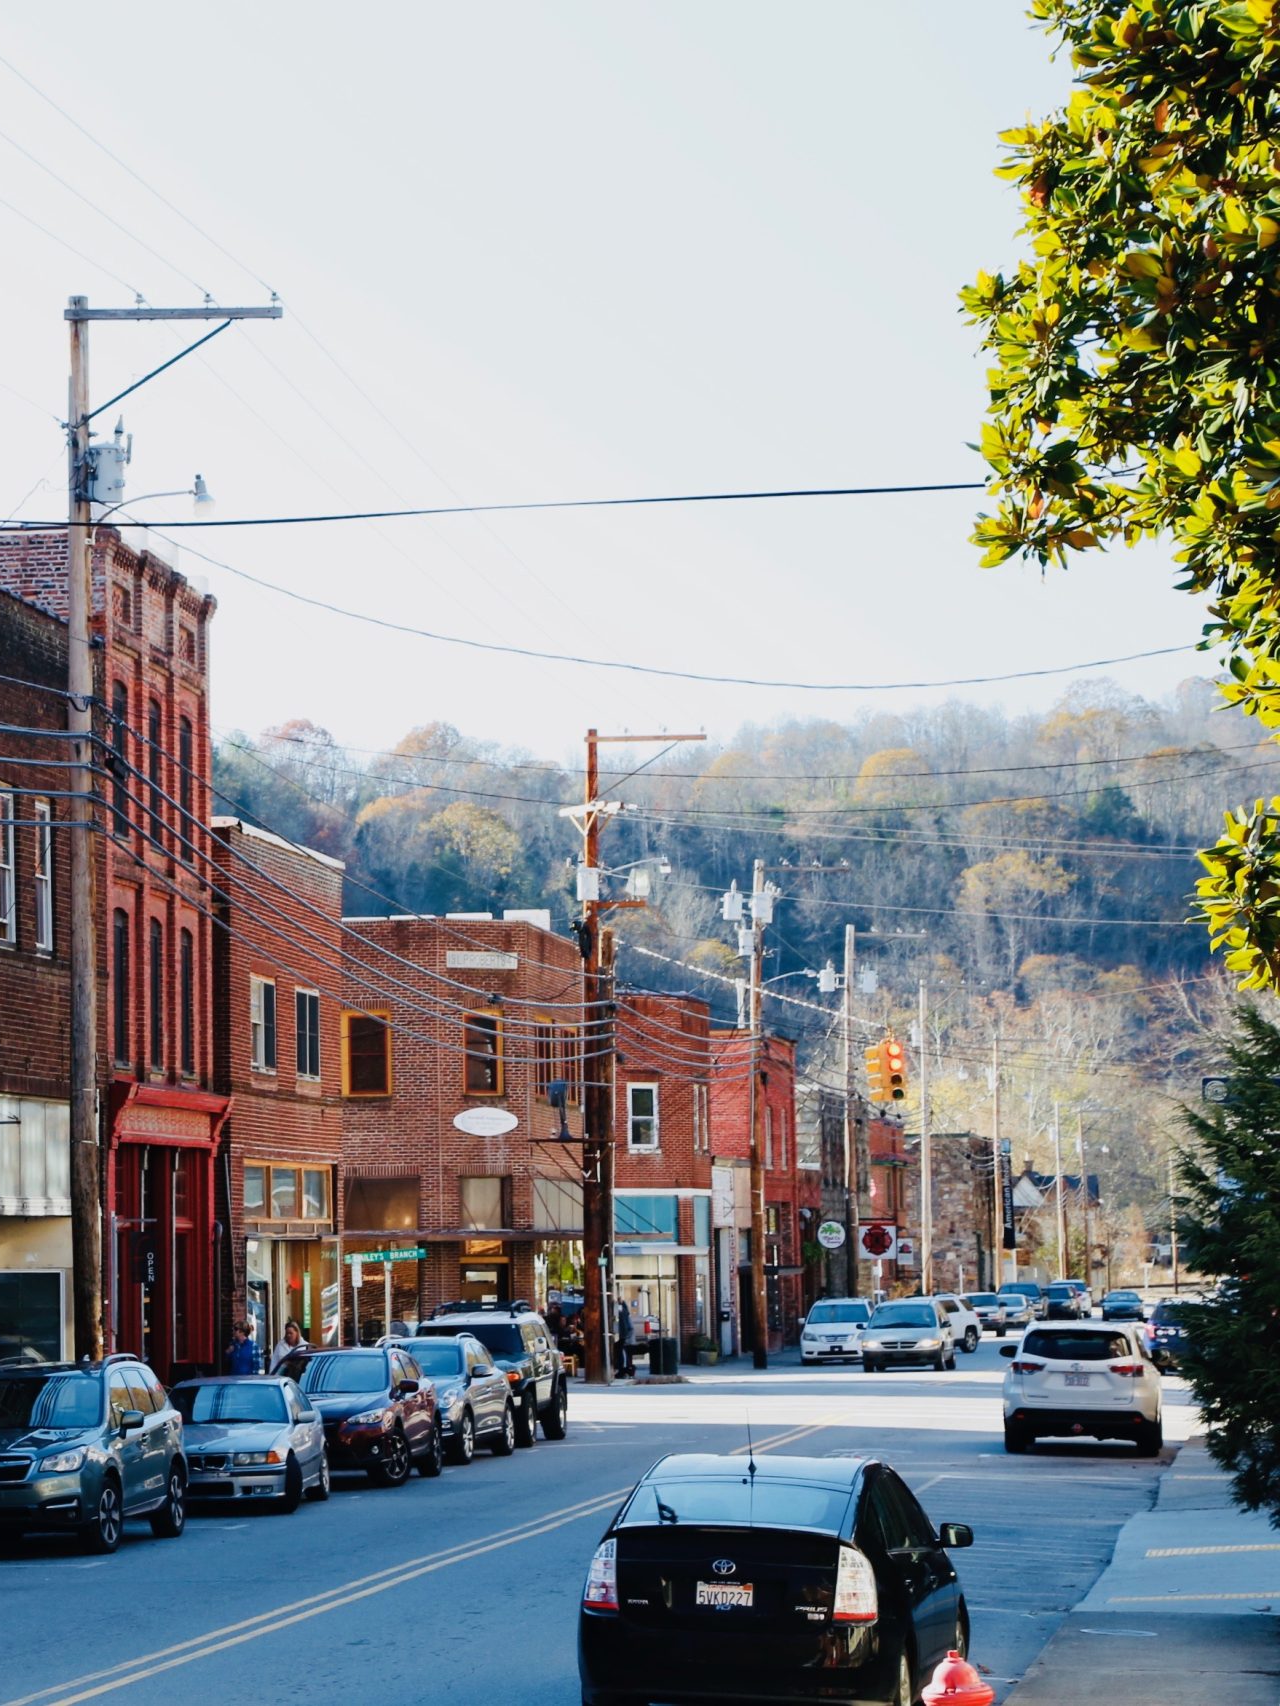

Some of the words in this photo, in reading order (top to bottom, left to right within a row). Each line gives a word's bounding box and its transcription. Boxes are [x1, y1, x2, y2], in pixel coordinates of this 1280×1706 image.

[1004, 1187, 1013, 1229] American
[389, 1250, 418, 1260] BRANCH
[146, 1252, 155, 1282] OPEN
[698, 1590, 751, 1606] 5VKD227
